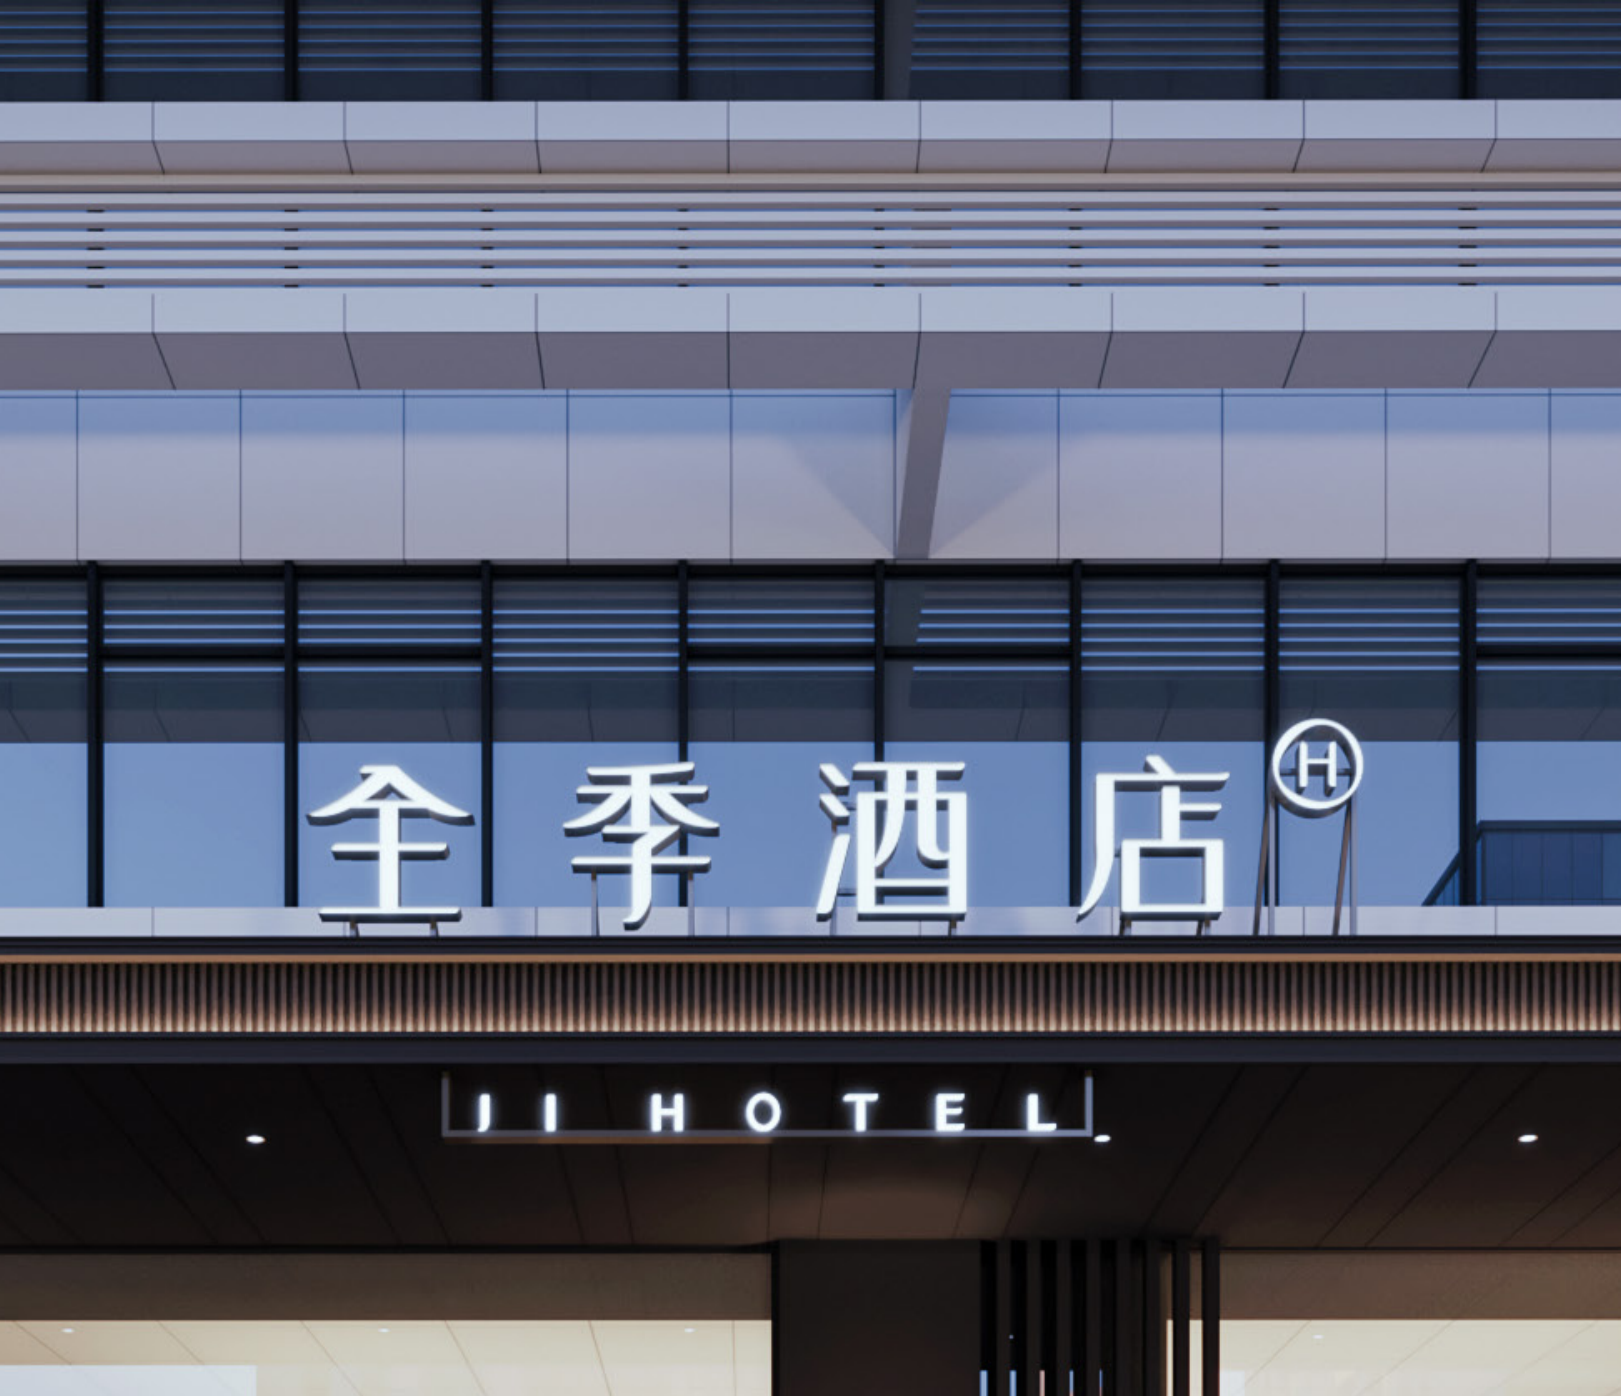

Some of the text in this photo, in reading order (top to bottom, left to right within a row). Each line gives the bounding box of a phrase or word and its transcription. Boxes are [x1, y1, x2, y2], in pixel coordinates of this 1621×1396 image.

[306, 754, 1232, 928] 全季酒店
[476, 1091, 1057, 1134] JI HOTEL
